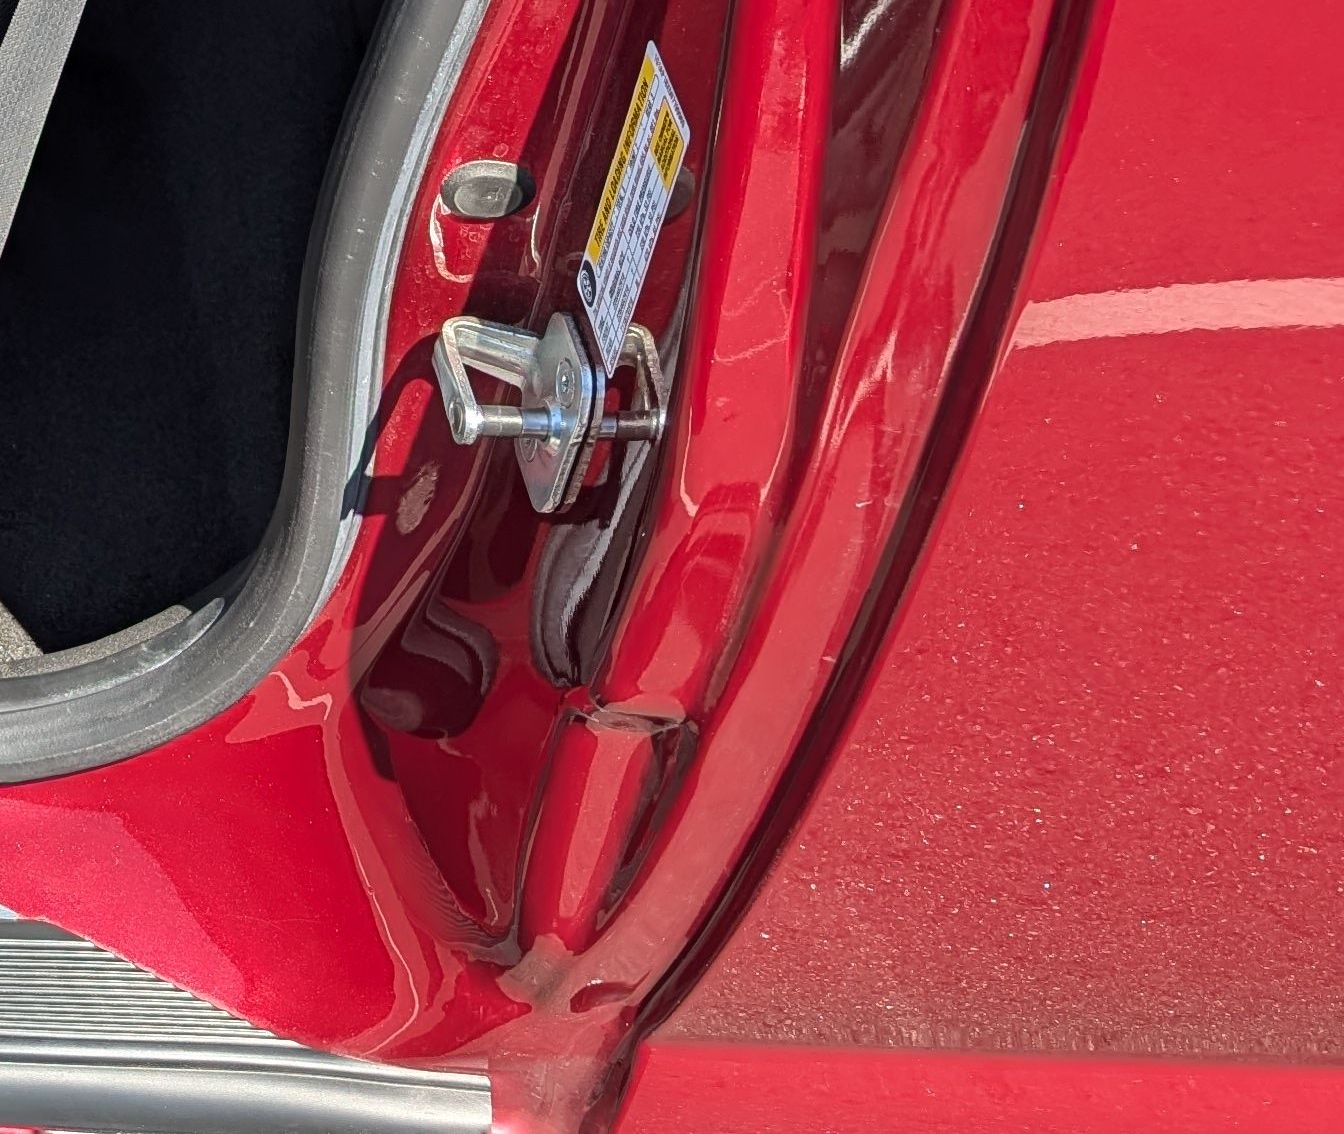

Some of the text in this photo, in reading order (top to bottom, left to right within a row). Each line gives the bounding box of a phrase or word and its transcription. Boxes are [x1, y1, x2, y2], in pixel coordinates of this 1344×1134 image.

[594, 76, 649, 248] TIRE AND LOADING INFORMATION
